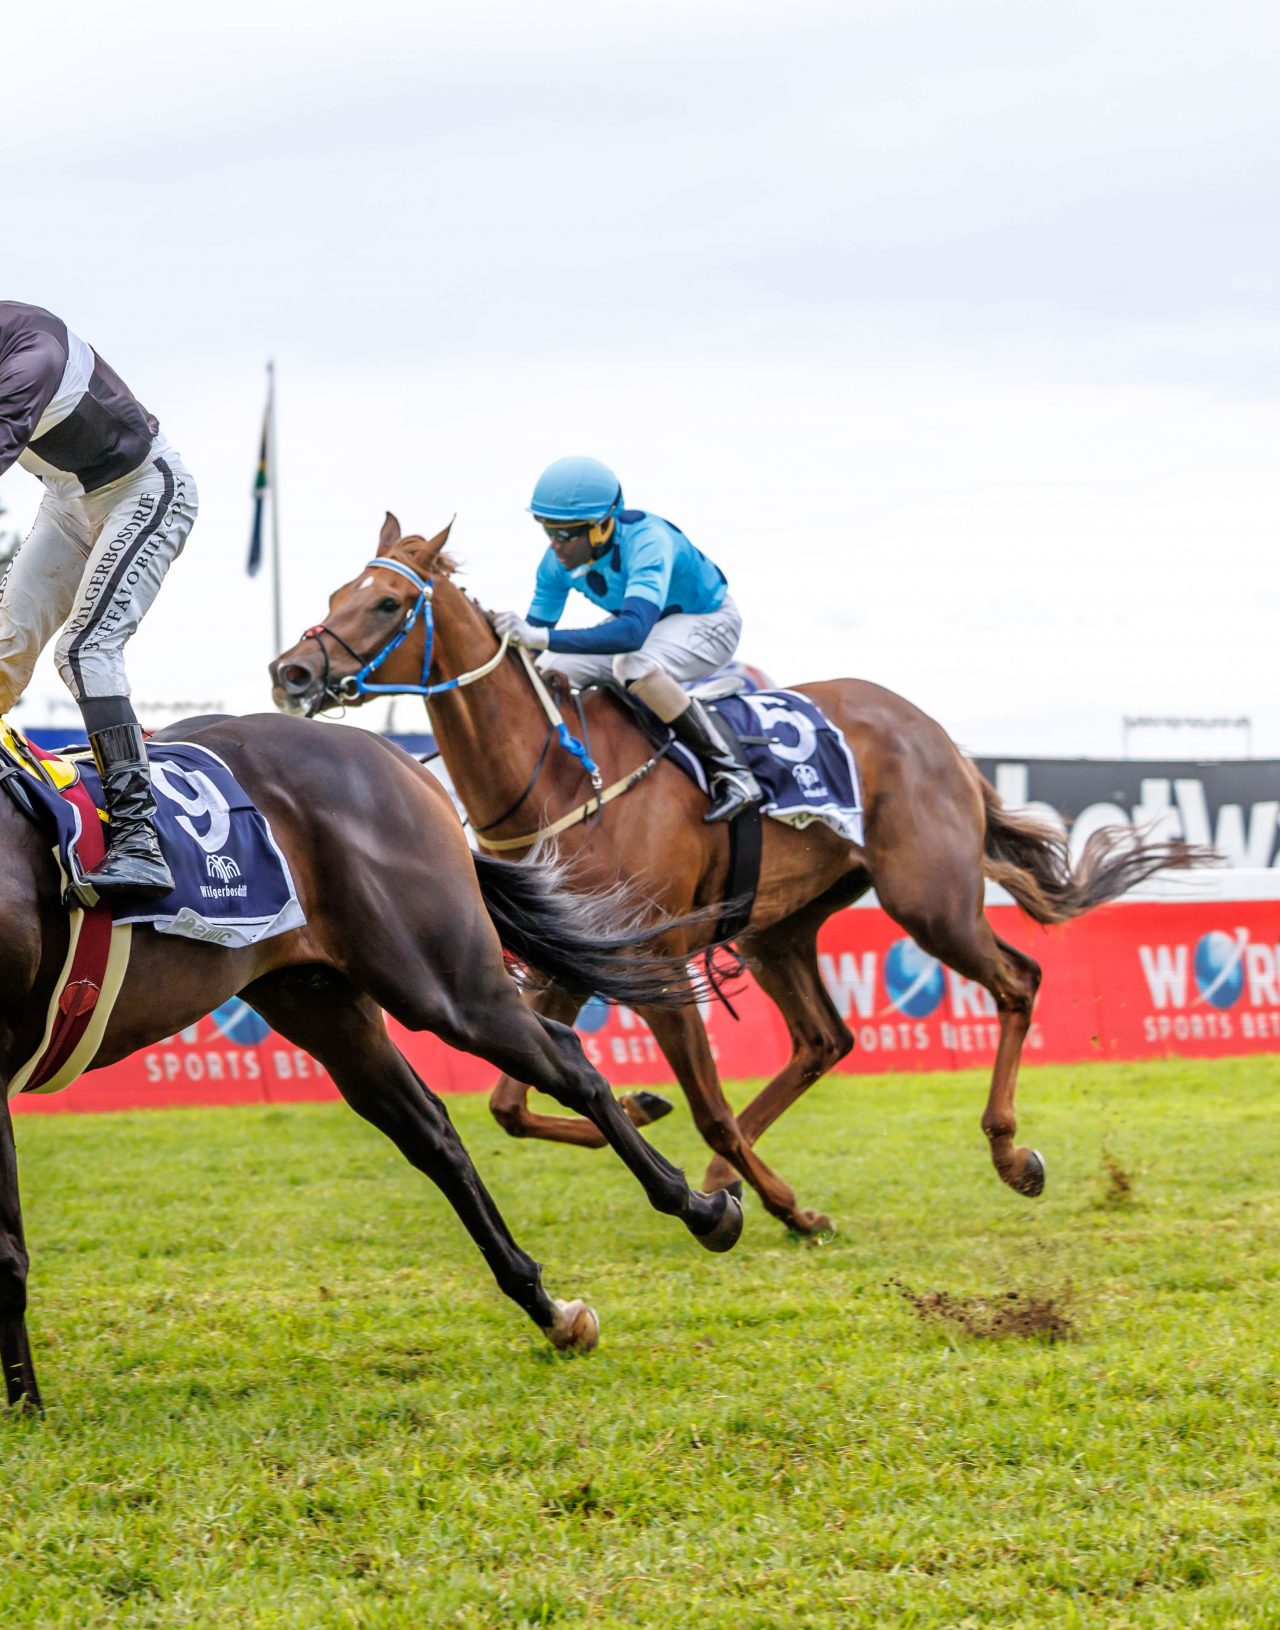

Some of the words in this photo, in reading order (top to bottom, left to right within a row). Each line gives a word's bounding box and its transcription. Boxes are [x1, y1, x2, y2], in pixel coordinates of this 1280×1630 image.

[739, 695, 817, 763] 5
[149, 760, 231, 853] 9
[859, 1023, 930, 1052] ORTS
[1143, 1014, 1233, 1043] SPORTS
[144, 1051, 262, 1082] SPORTS
